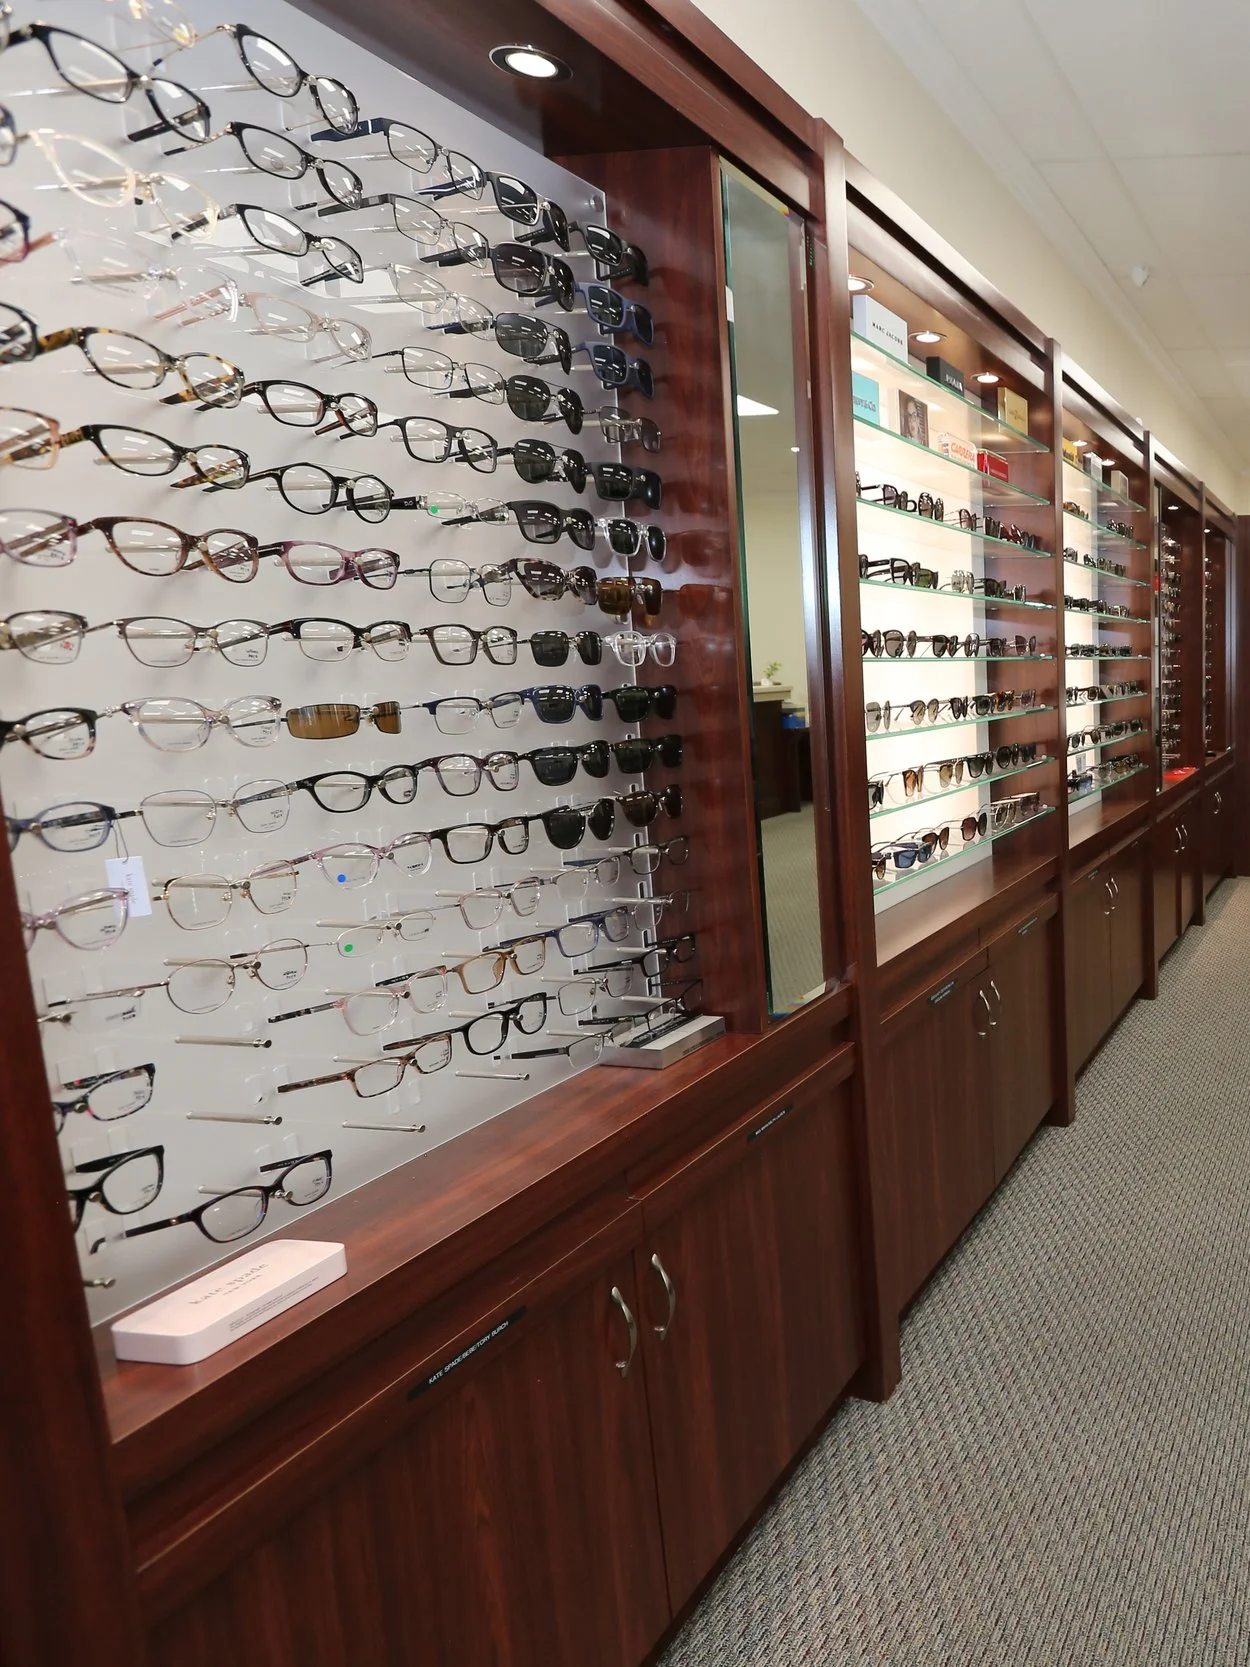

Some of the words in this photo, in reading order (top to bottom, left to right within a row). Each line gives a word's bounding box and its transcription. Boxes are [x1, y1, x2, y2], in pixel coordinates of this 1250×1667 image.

[872, 321, 886, 334] MARC
[886, 330, 904, 346] JACOBS
[950, 442, 976, 463] CARRERA
[189, 1286, 223, 1305] kate
[226, 1263, 269, 1288] spade
[428, 1369, 444, 1385] KATE
[491, 1320, 509, 1337] BURCH
